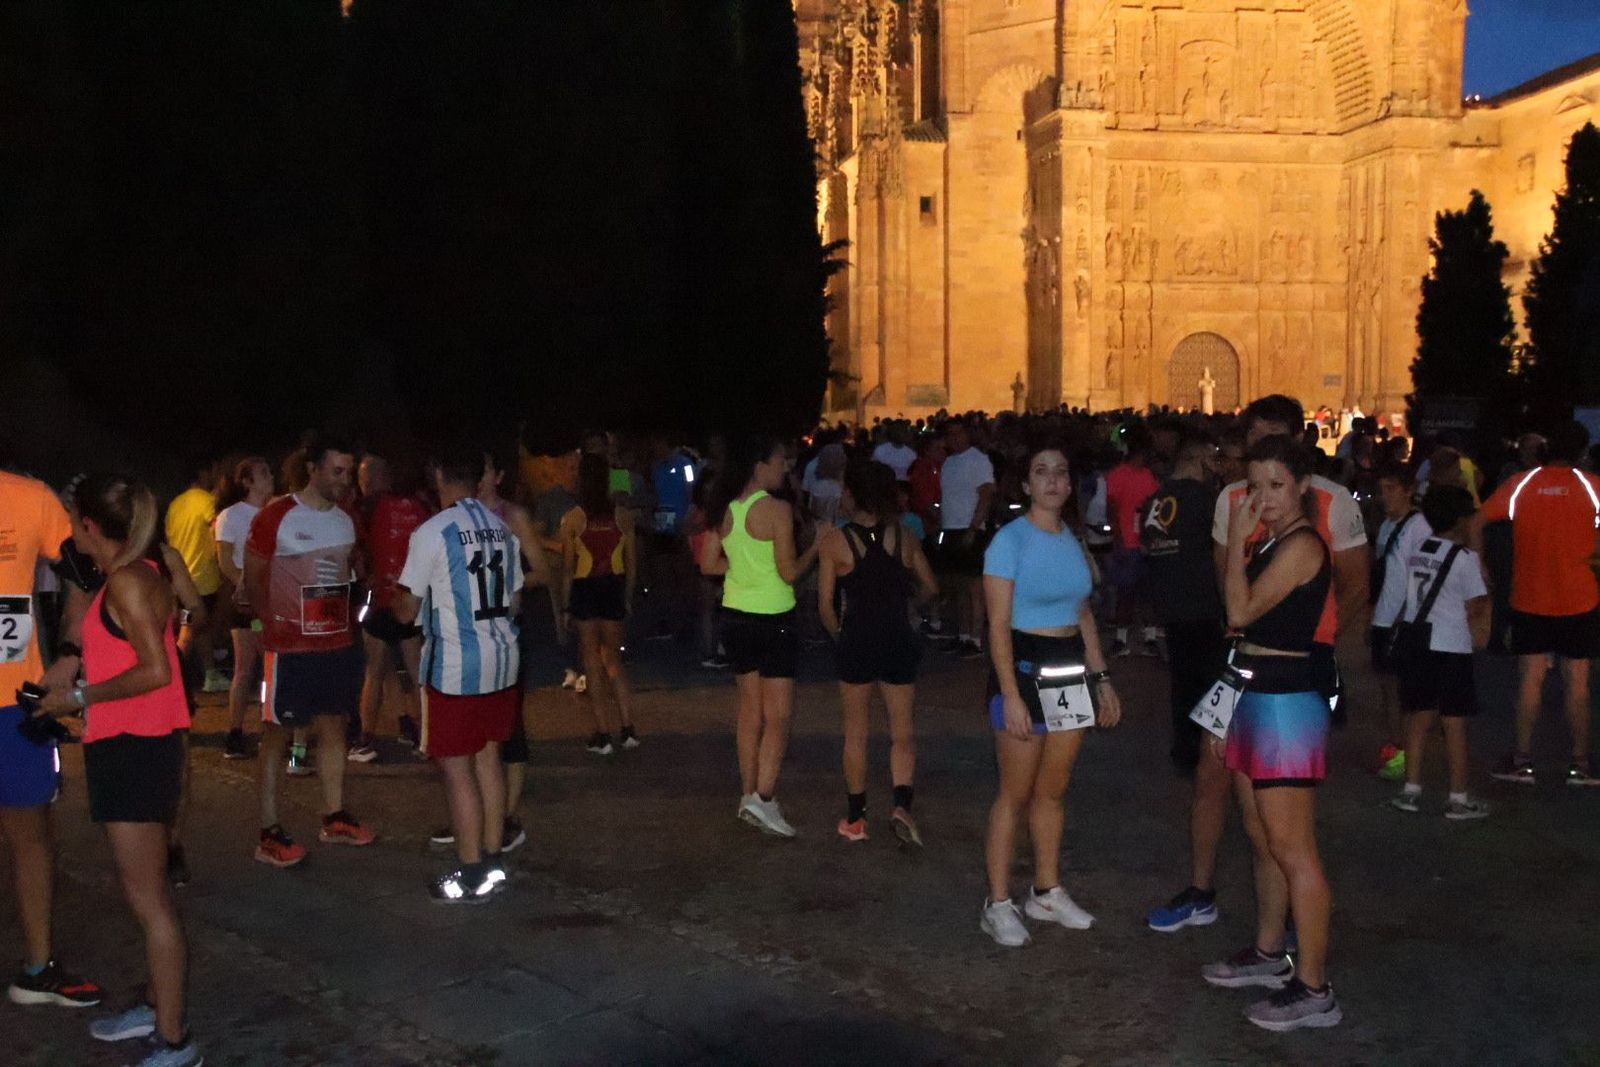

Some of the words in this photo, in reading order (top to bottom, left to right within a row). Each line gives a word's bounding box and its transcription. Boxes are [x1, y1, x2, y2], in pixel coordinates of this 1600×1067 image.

[458, 530, 473, 546] DI
[466, 550, 511, 621] 11
[1413, 571, 1431, 609] 7
[2, 617, 18, 640] 2
[1057, 690, 1069, 709] 4
[1210, 685, 1224, 707] 5
